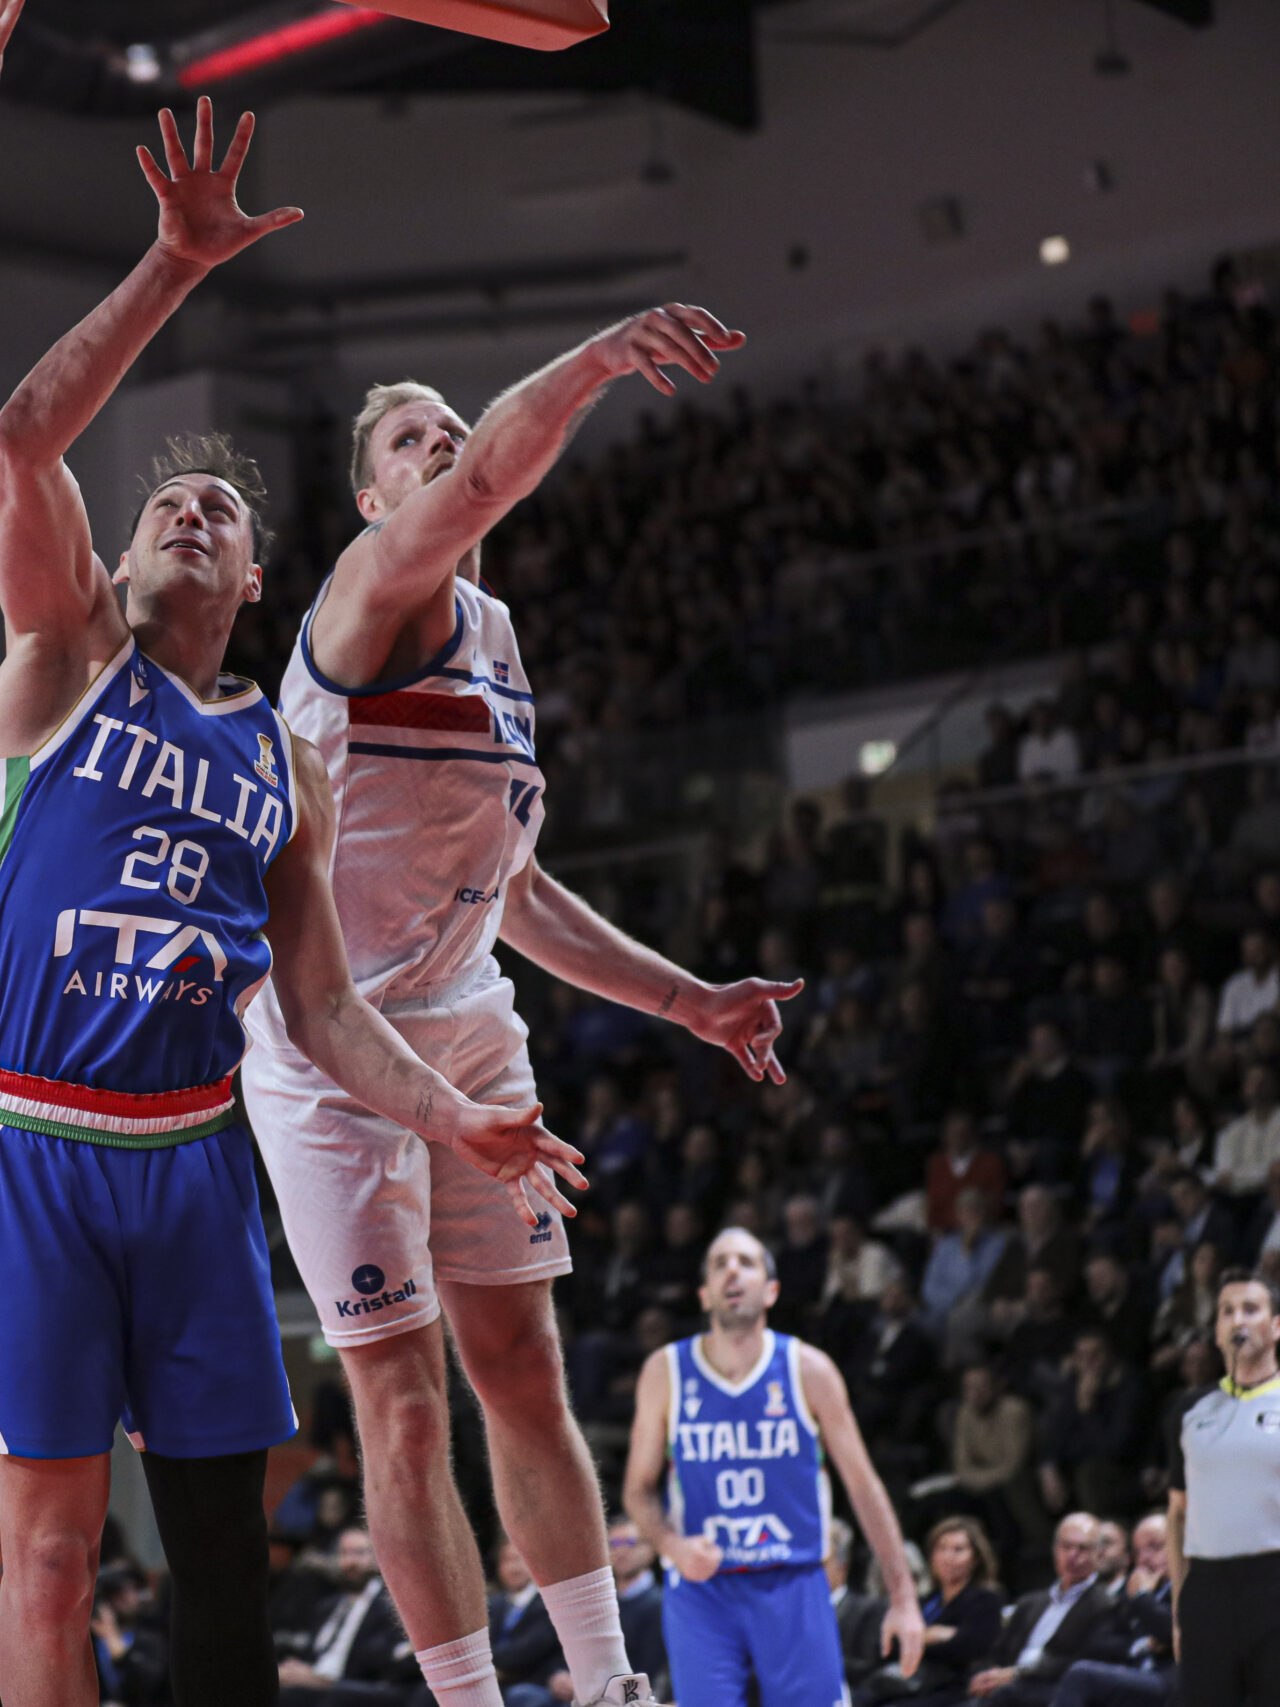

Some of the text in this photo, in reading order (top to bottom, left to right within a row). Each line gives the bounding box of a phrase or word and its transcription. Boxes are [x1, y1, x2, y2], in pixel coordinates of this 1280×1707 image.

[72, 713, 285, 864] ITALIA
[120, 826, 209, 905] 28
[54, 908, 228, 981] ITA
[63, 969, 213, 1006] AIRWAYS
[335, 1279, 417, 1318] Kristall
[677, 1418, 800, 1462] ITALIA
[716, 1468, 765, 1509] 00
